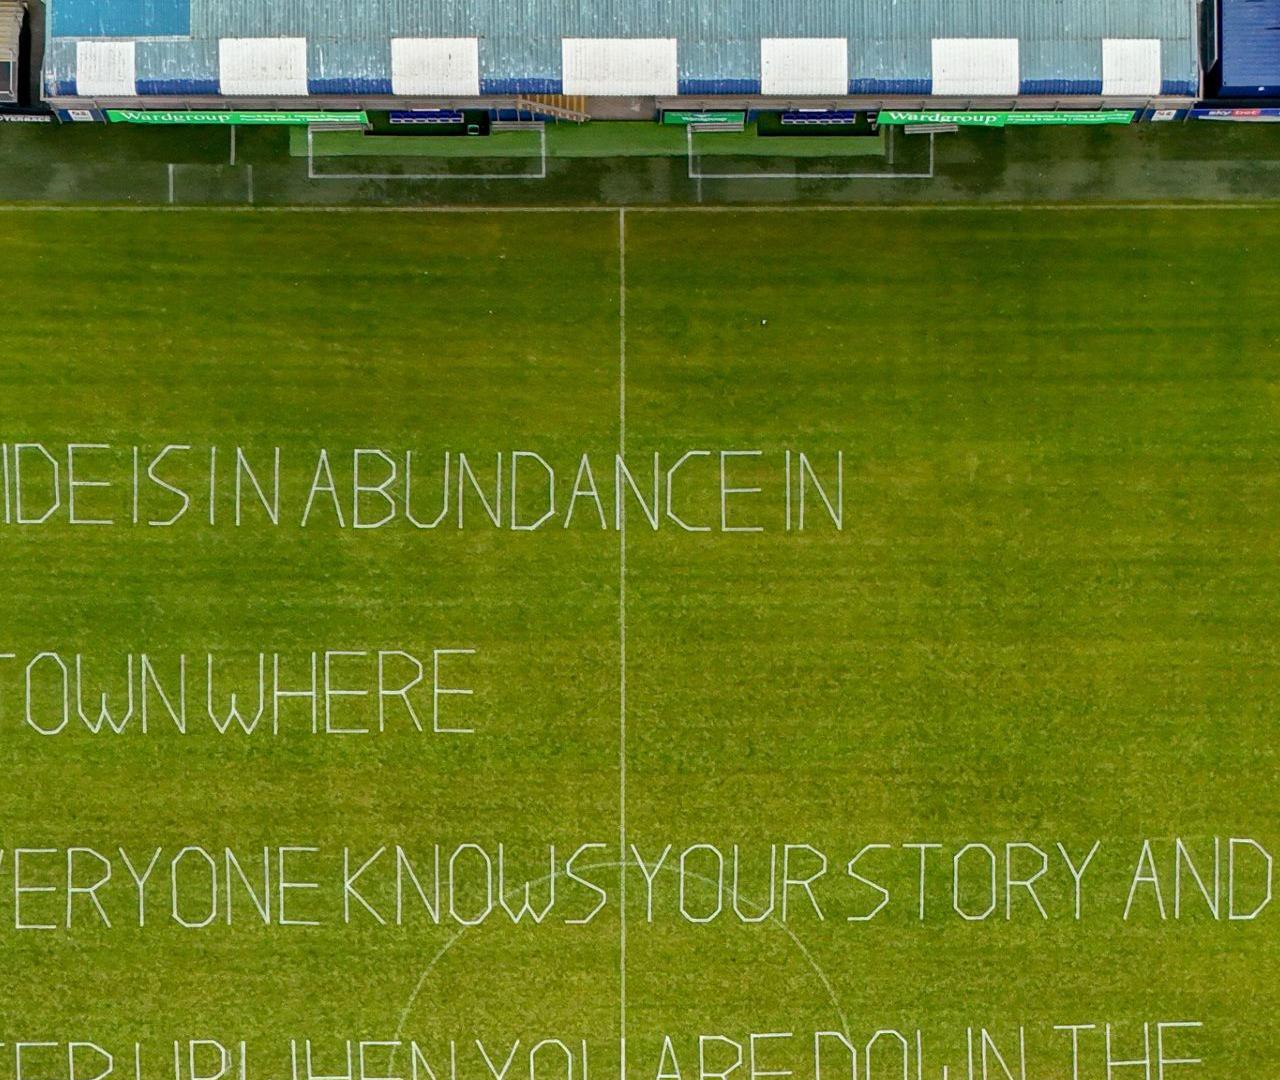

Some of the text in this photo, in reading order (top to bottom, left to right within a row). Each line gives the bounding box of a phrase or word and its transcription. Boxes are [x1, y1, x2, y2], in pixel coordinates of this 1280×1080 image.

[120, 111, 231, 123] Wardgroup
[887, 112, 997, 124] Wardgroup
[134, 445, 189, 525] IS
[210, 447, 279, 525] IN
[302, 449, 761, 531] ABUNDANCE
[786, 451, 841, 529] IN
[208, 650, 473, 734] WHERE
[344, 844, 606, 925] KNOWS
[631, 844, 826, 924] YOUR
[848, 842, 1099, 920] STORY
[1124, 838, 1272, 919] AND
